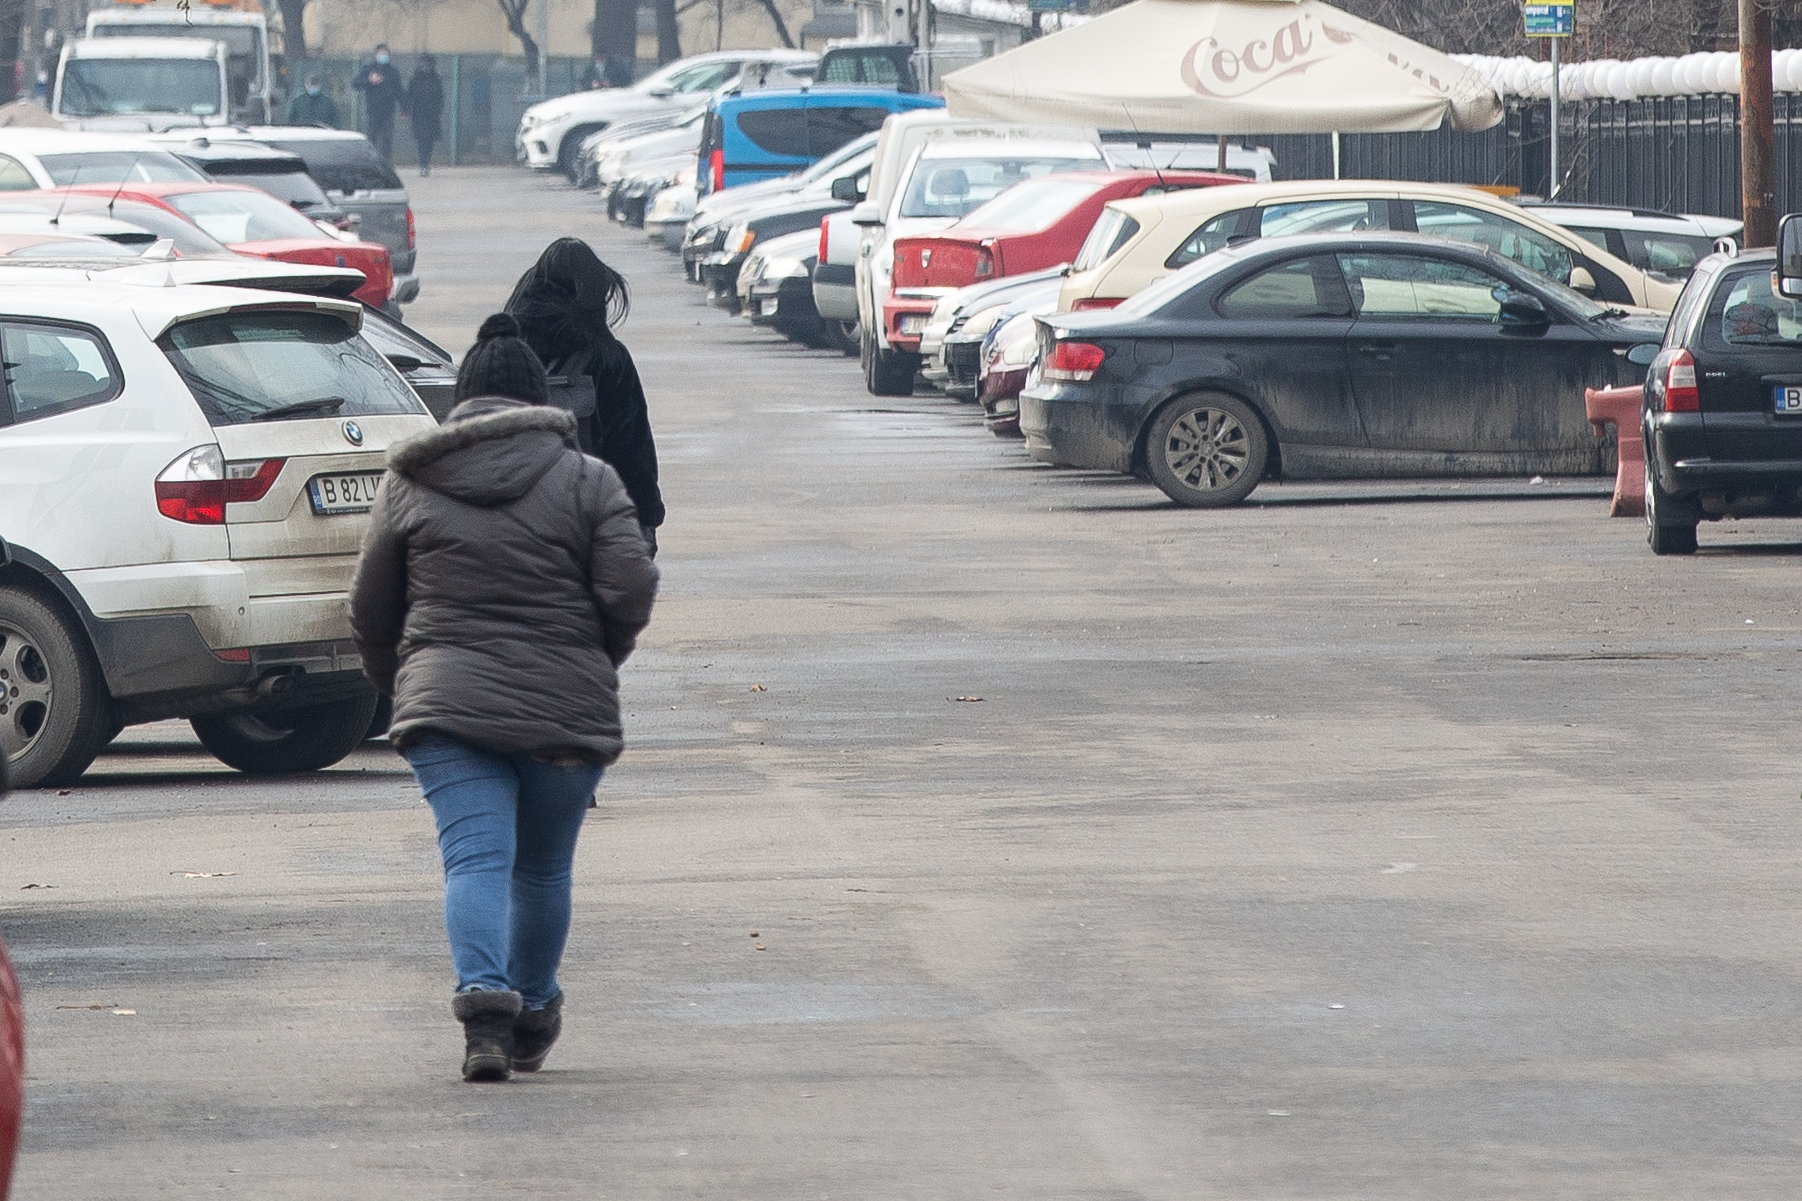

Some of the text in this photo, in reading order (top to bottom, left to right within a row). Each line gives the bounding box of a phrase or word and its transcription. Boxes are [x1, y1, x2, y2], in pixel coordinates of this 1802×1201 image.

[1180, 13, 1326, 98] Coca
[1787, 389, 1801, 408] B
[322, 478, 337, 504] B
[340, 478, 361, 503] 82
